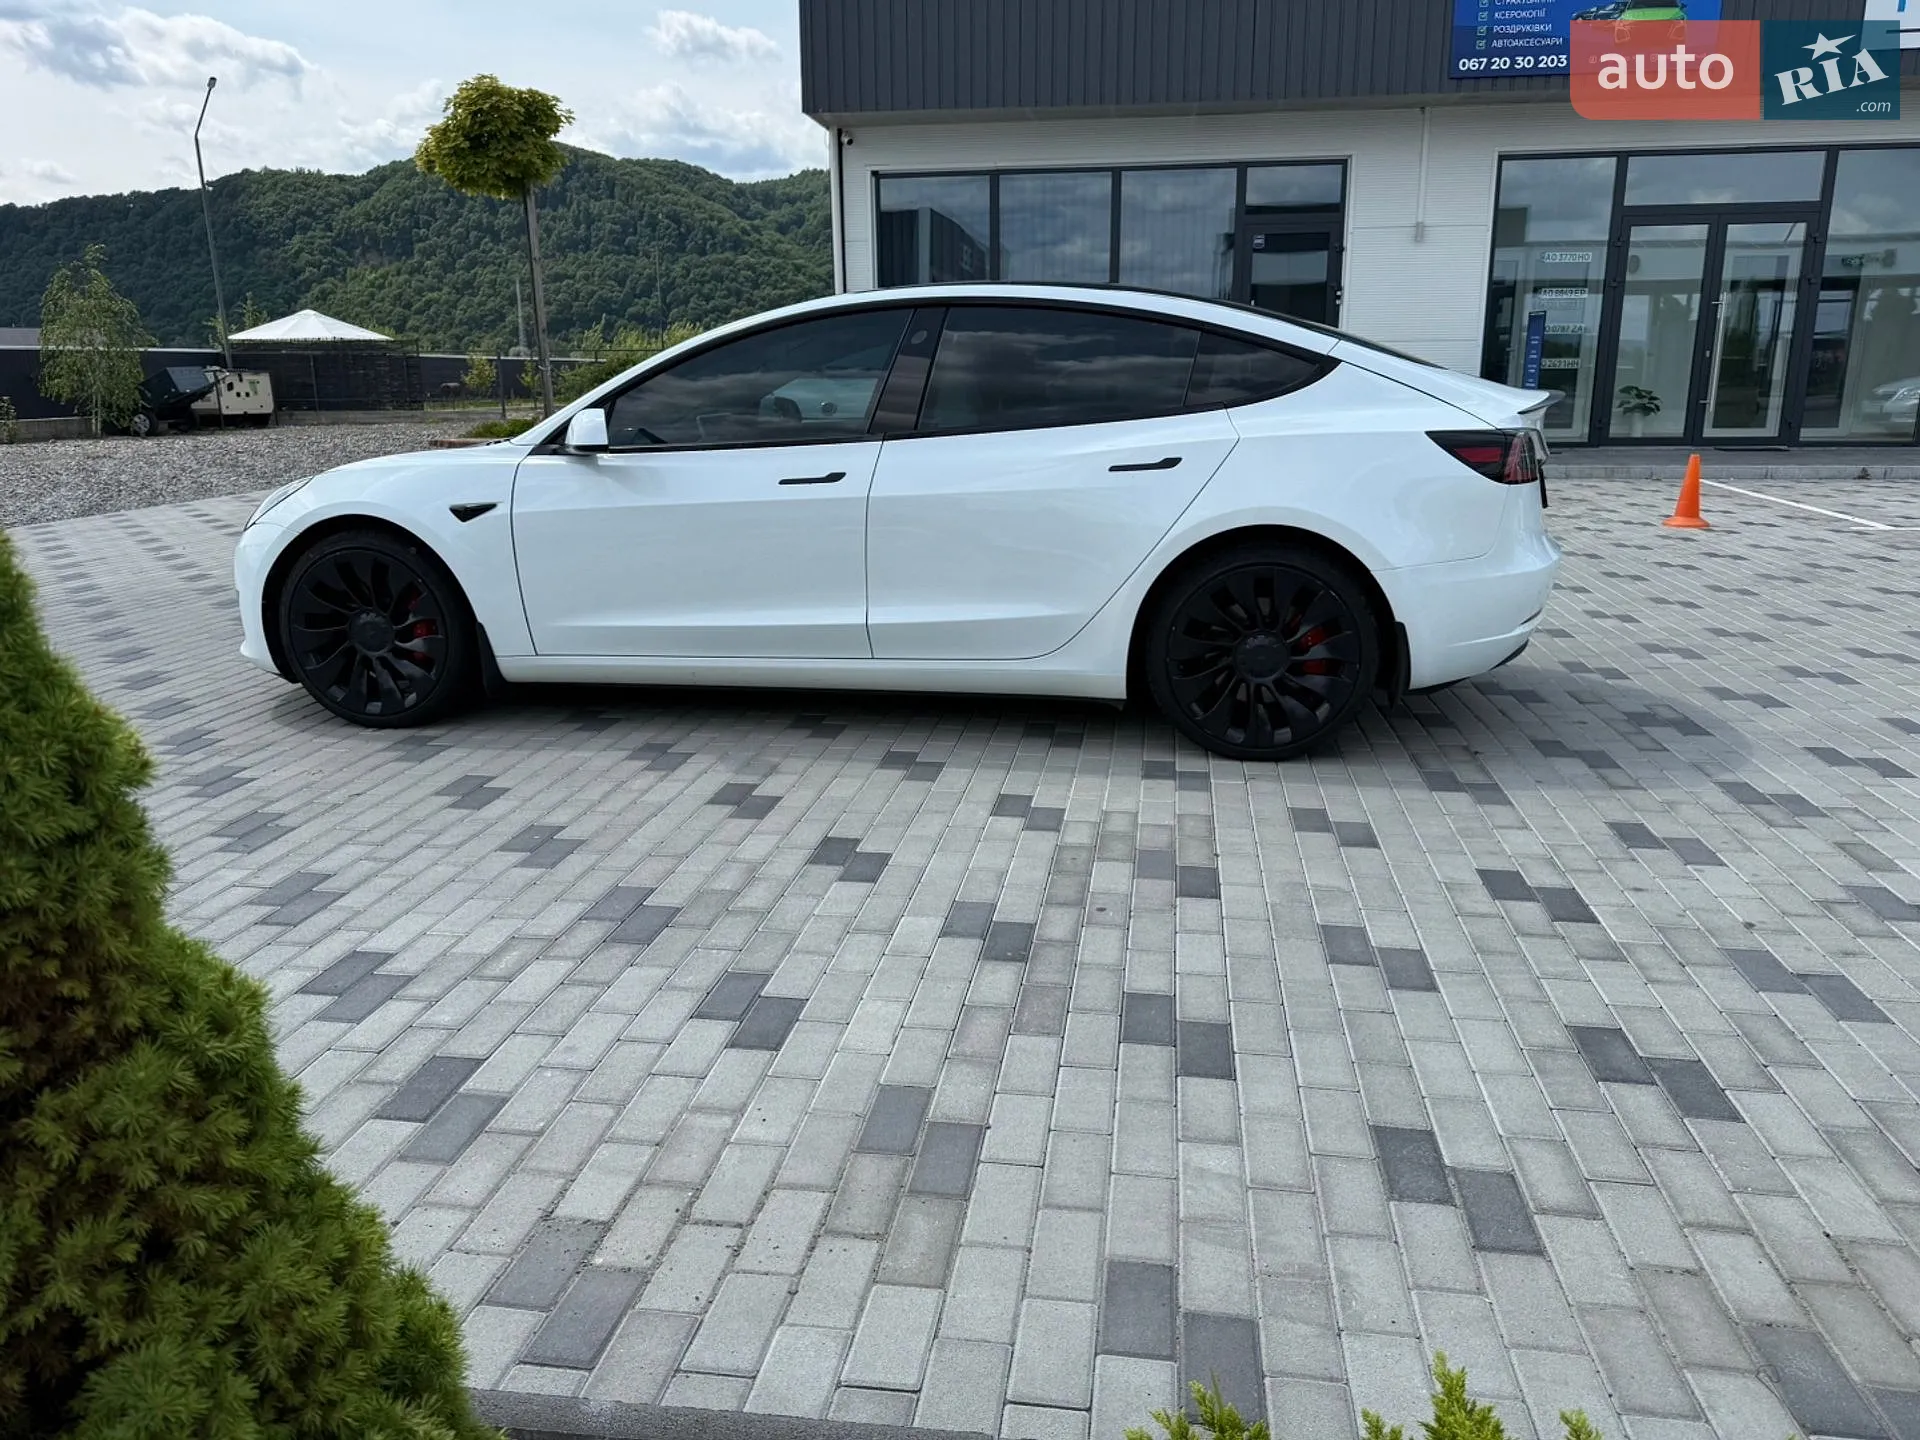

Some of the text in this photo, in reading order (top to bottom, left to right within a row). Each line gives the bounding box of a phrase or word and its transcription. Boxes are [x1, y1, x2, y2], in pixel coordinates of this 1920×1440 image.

[1494, 8, 1546, 19] КСЕРОКОПІЇ
[1493, 23, 1552, 34] РОЗДРУКІВКИ
[1491, 37, 1563, 47] АВТОАКСЕСУАРИ
[1458, 55, 1568, 71] 067 20 30 203
